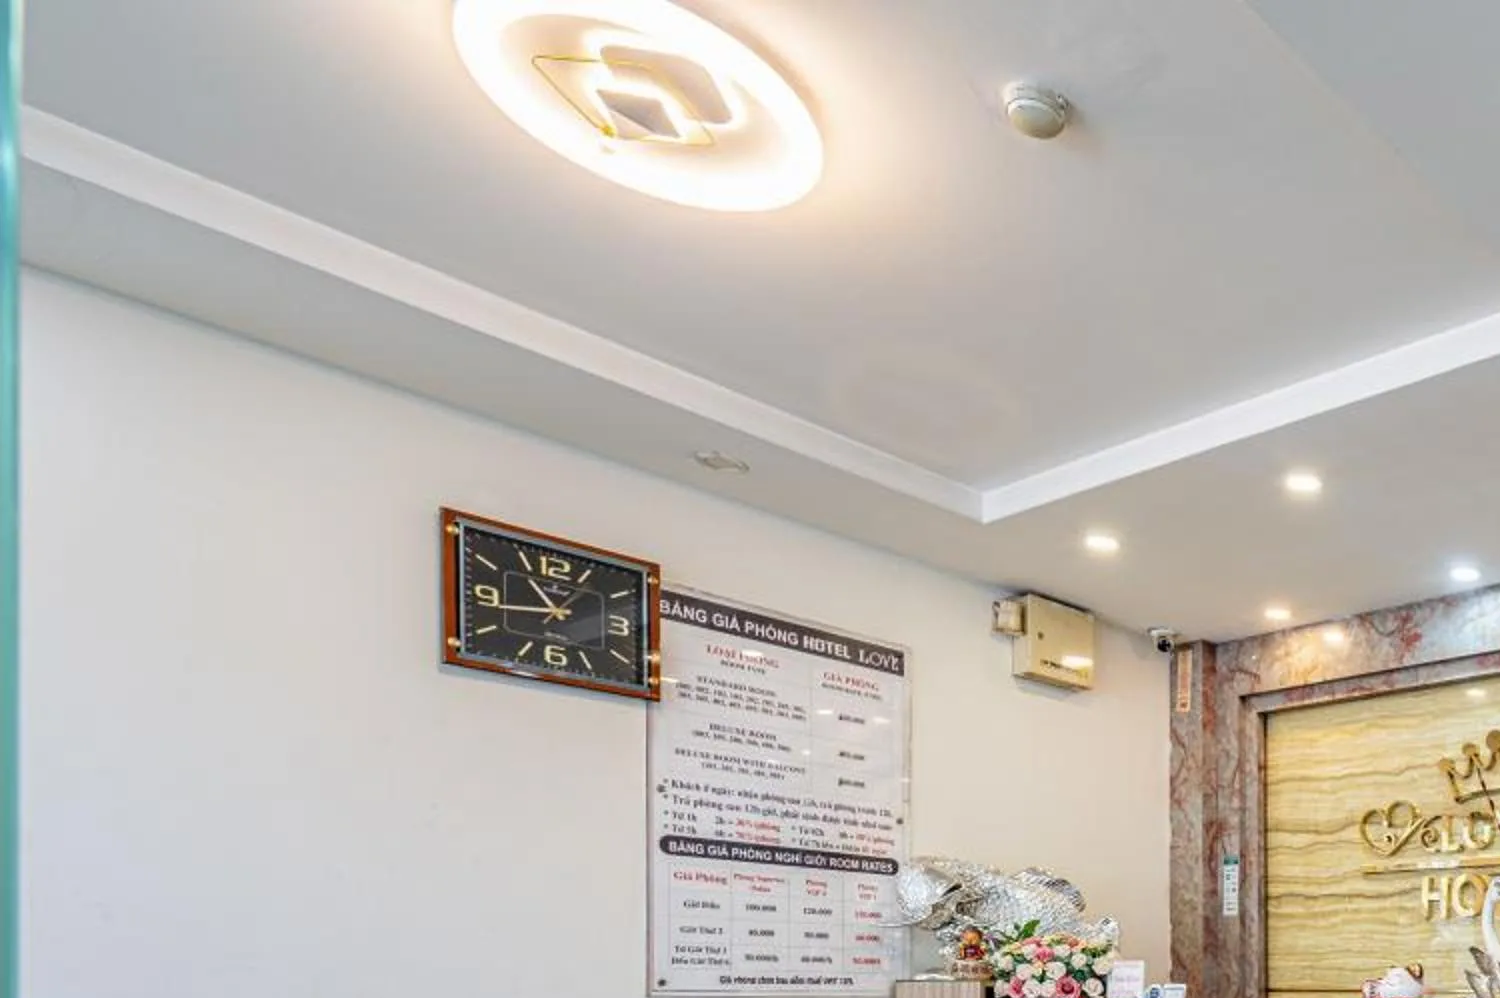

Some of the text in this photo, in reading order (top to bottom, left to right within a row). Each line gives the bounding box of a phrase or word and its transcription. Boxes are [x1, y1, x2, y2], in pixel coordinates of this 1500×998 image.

[539, 556, 572, 581] 12
[475, 585, 499, 607] 9
[607, 614, 630, 637] 3
[543, 644, 568, 667] 6
[803, 635, 851, 659] HOTEL
[859, 649, 900, 671] LOVE
